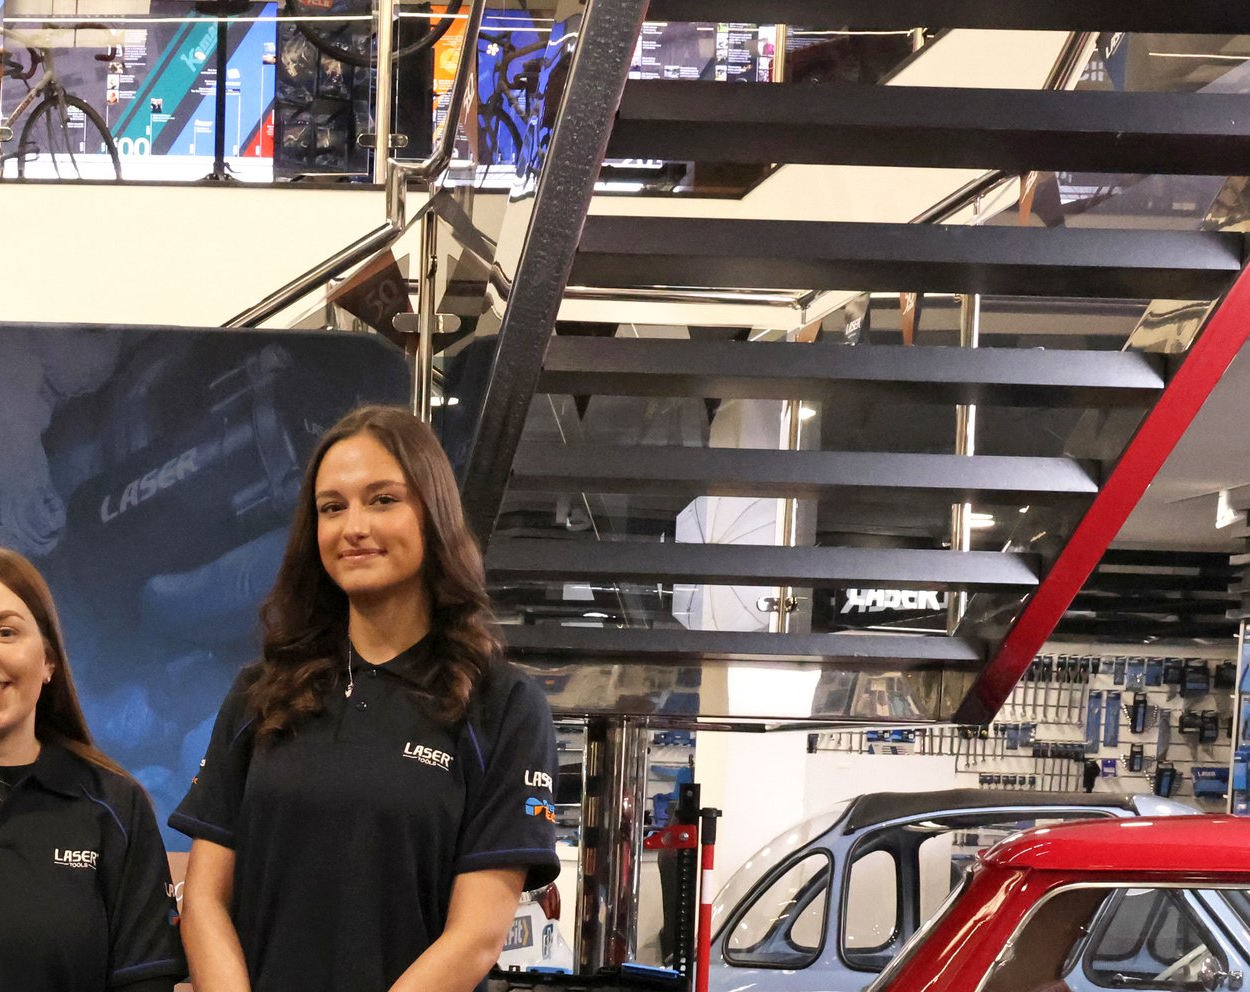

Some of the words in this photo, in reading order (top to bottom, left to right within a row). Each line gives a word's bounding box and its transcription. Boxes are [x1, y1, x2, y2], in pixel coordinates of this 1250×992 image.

[100, 447, 199, 523] LASER
[404, 742, 451, 767] LASER
[54, 848, 97, 866] LASER
